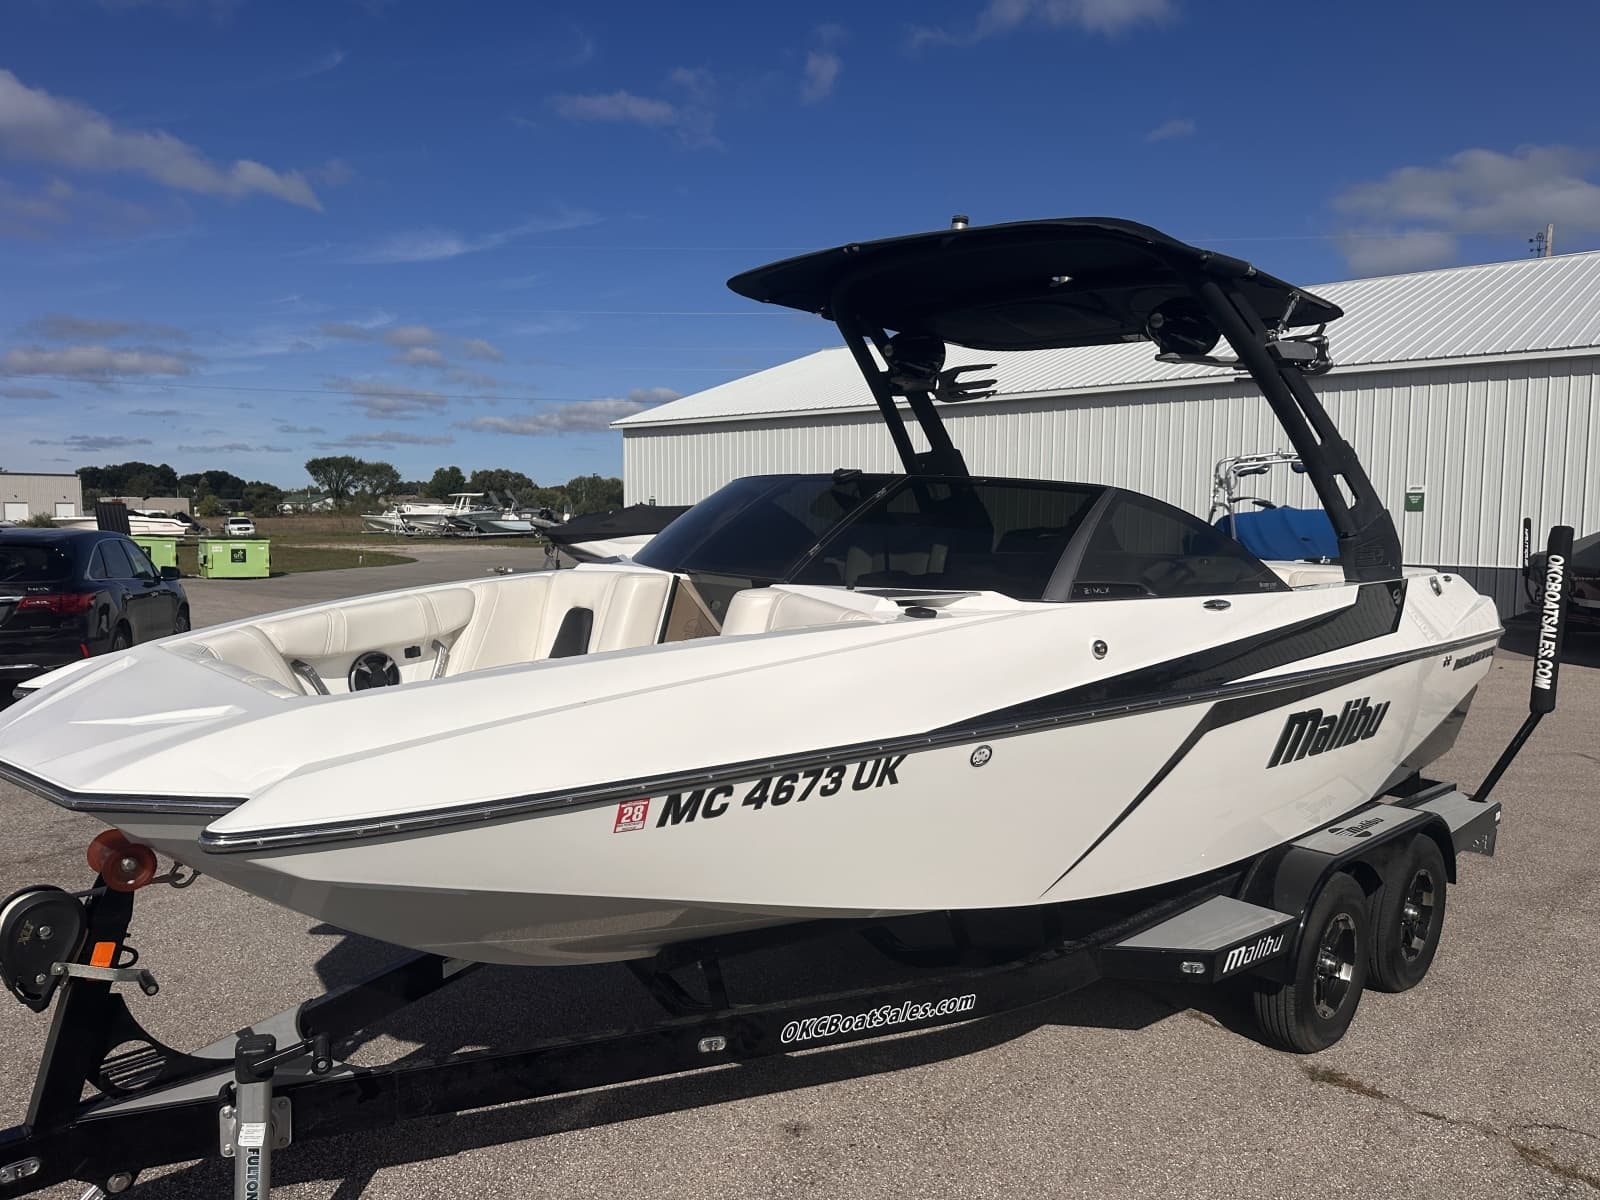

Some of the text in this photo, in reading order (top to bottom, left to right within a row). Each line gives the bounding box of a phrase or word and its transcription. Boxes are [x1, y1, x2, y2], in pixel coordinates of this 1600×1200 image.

[1534, 554, 1565, 691] OKCBOATSALES.COM
[1265, 696, 1391, 770] Malibu
[620, 804, 645, 823] 28
[655, 753, 908, 829] MC 4673 UK
[1222, 934, 1285, 975] Malibu
[780, 993, 977, 1044] OKCBoatSales.com
[244, 1146, 262, 1200] FULTON
